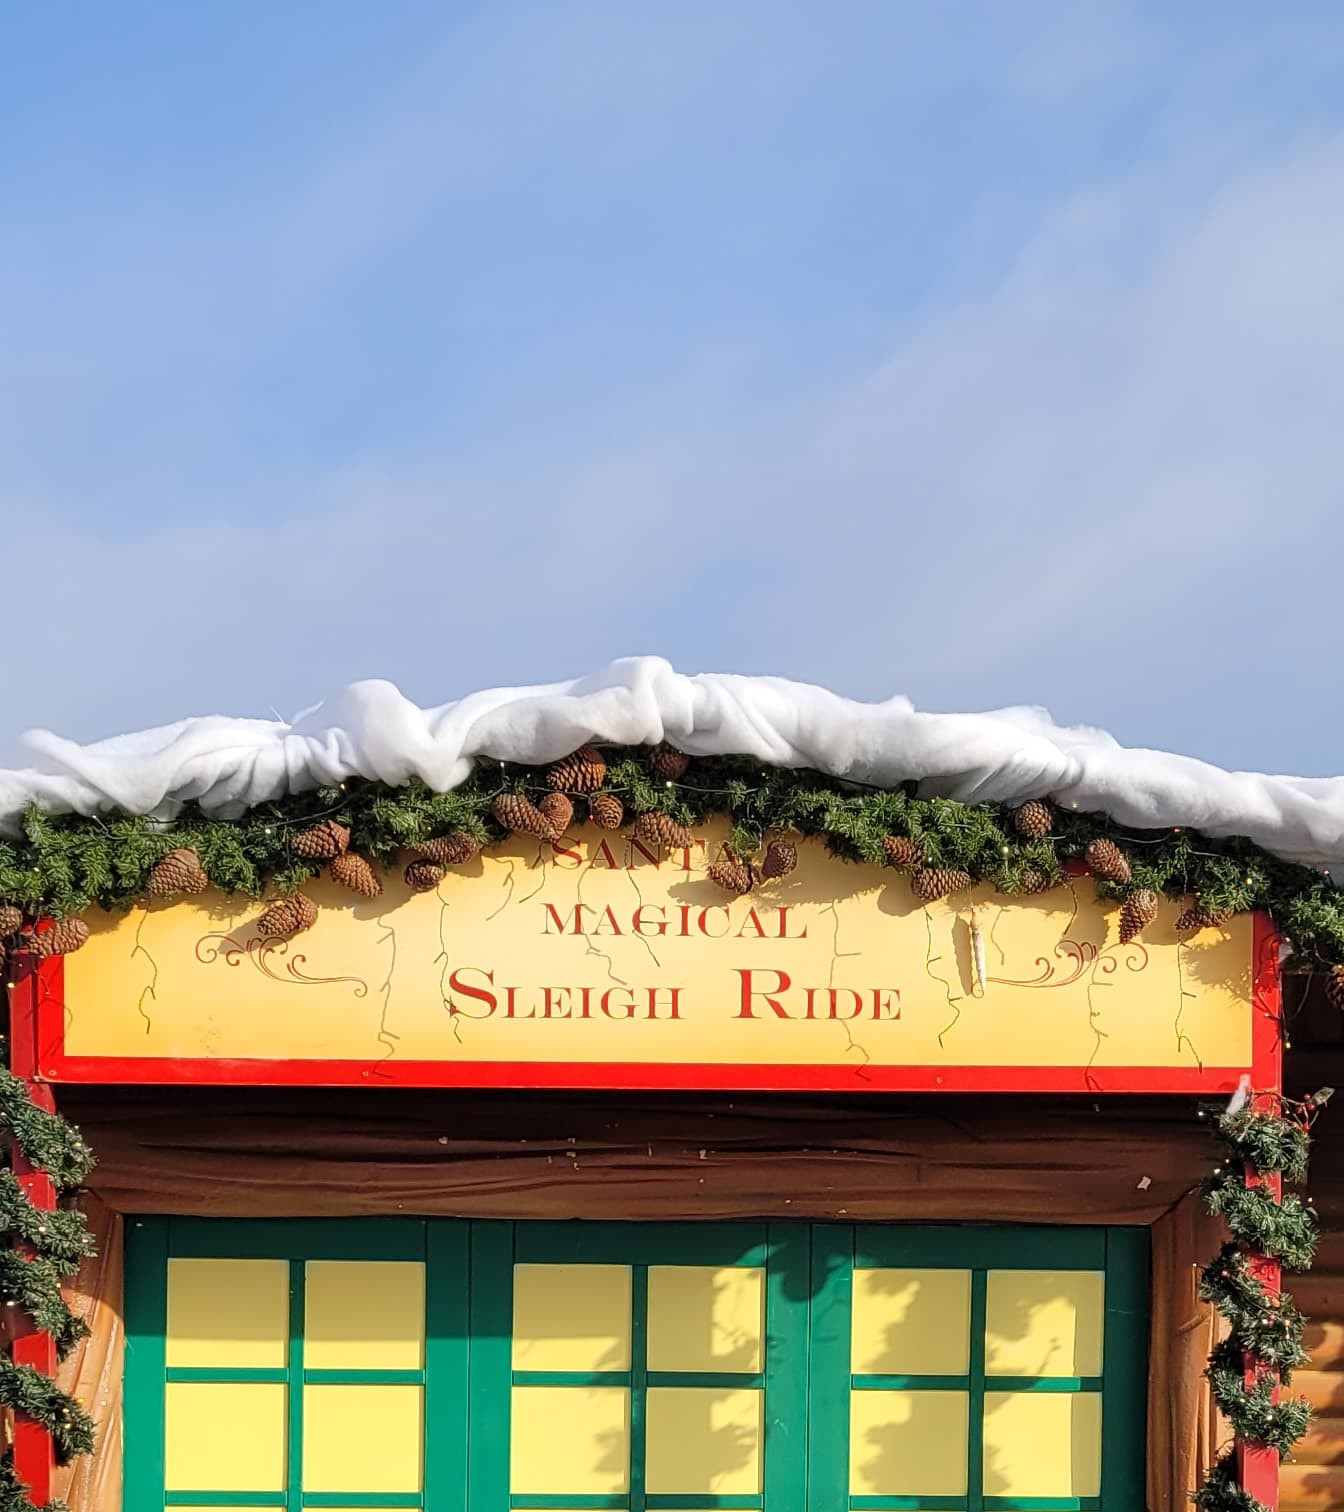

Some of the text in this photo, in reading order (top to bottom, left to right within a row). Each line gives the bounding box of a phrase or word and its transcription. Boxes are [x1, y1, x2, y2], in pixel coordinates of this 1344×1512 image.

[540, 903, 808, 939] MAGICAL
[447, 967, 902, 1021] SLEIGH RIDE
